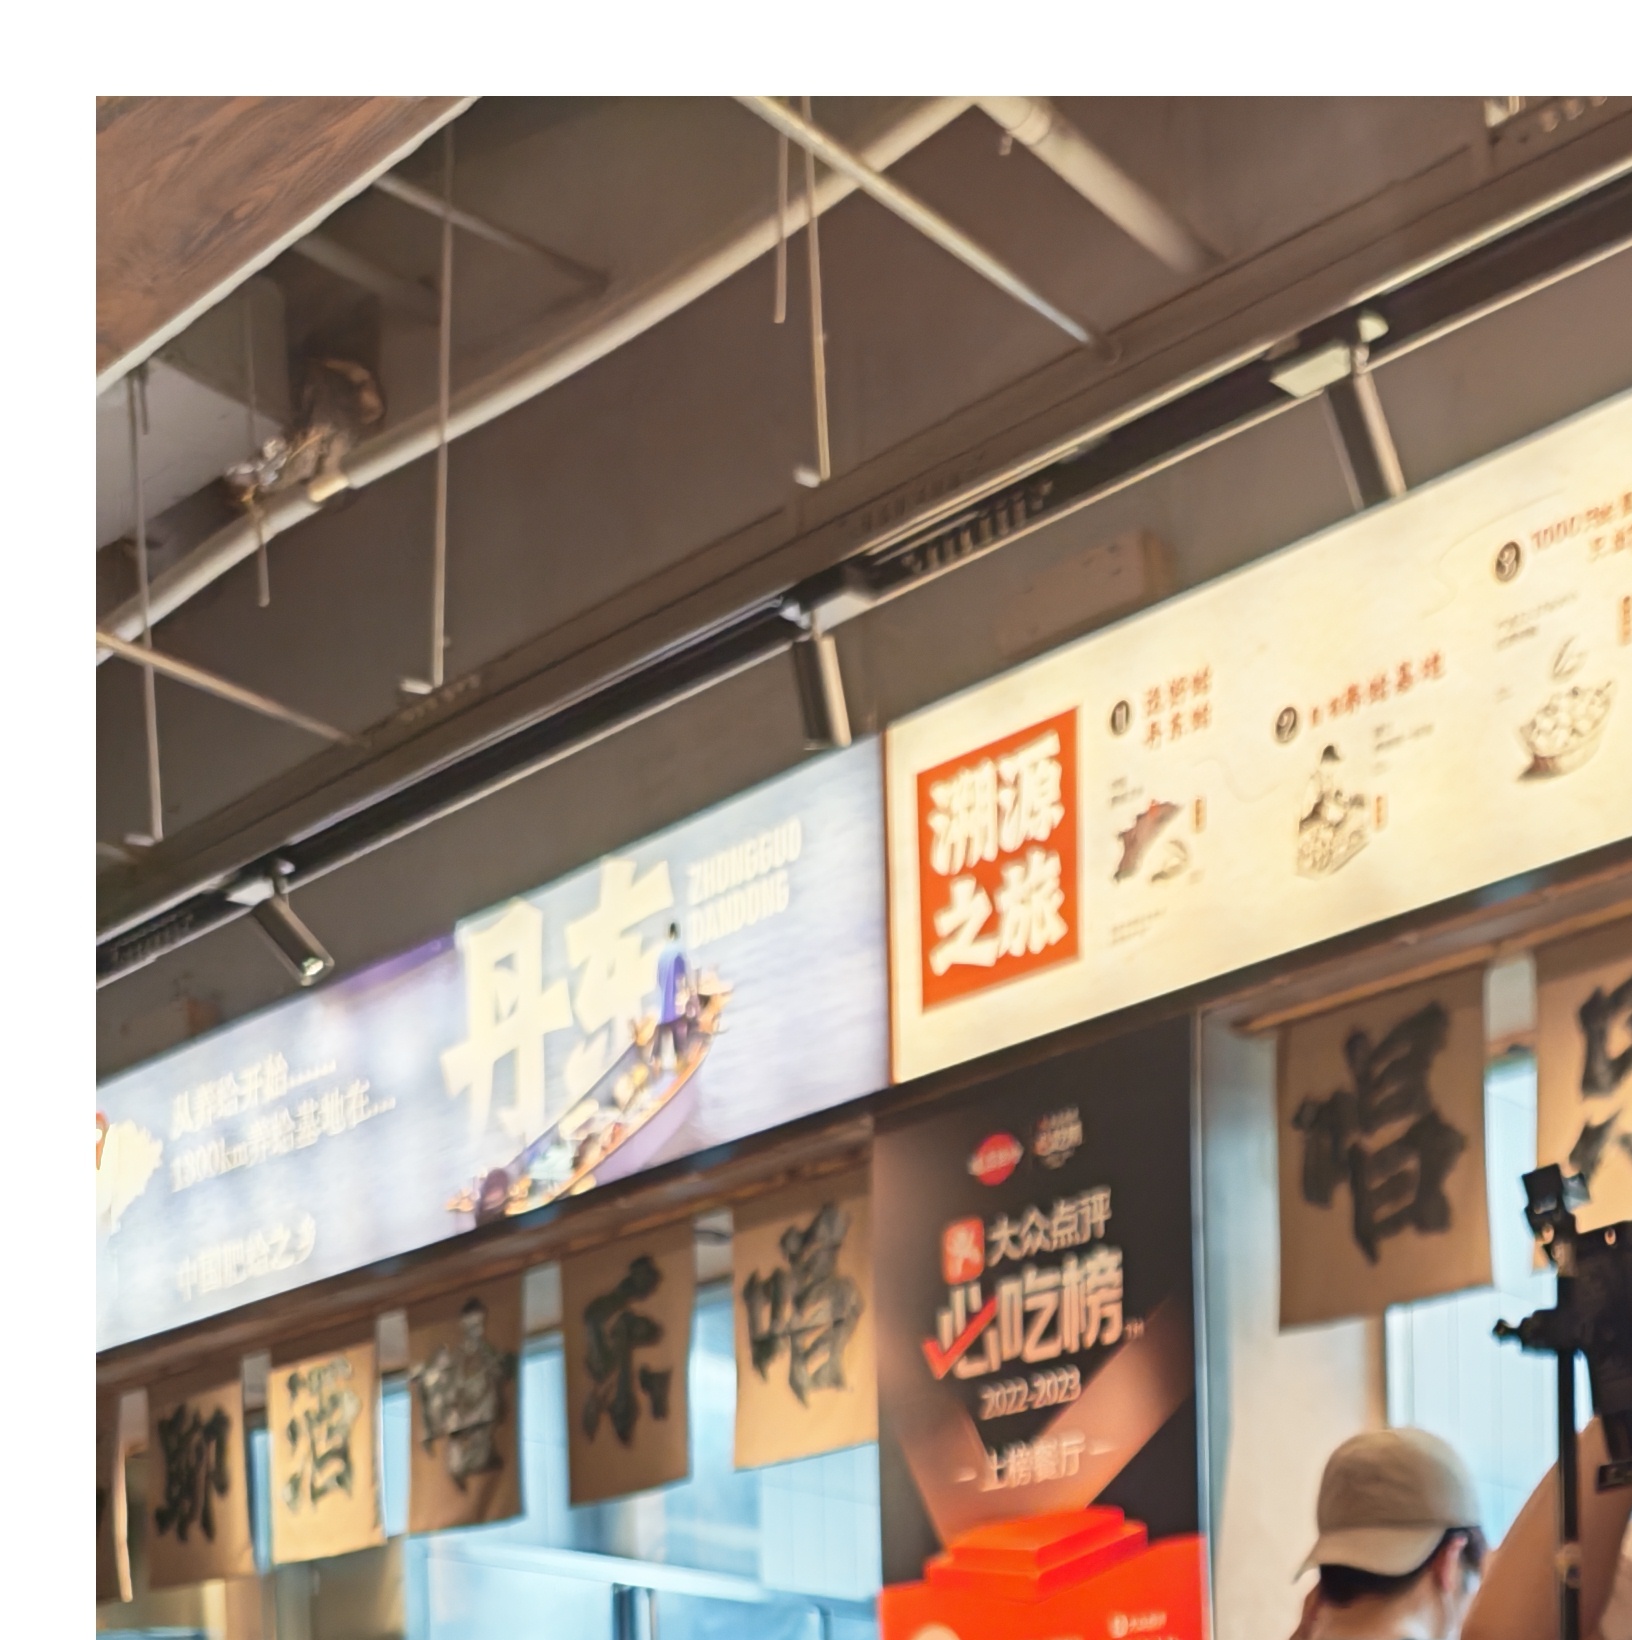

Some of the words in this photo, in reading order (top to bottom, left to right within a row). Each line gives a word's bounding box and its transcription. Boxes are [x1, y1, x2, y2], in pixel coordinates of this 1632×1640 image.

[928, 729, 1063, 875] 溯源
[686, 816, 803, 906] ZHONGGUO
[686, 869, 791, 950] DANDONG
[929, 849, 1068, 976] 之旅
[440, 860, 675, 1148] 丹东
[987, 1184, 1112, 1268] 大众点评
[582, 1255, 673, 1448] 乐
[928, 1243, 1124, 1381] 必吃榜
[978, 1363, 1083, 1421] 2022-2023
[980, 1430, 1086, 1493] 上榜餐厅
